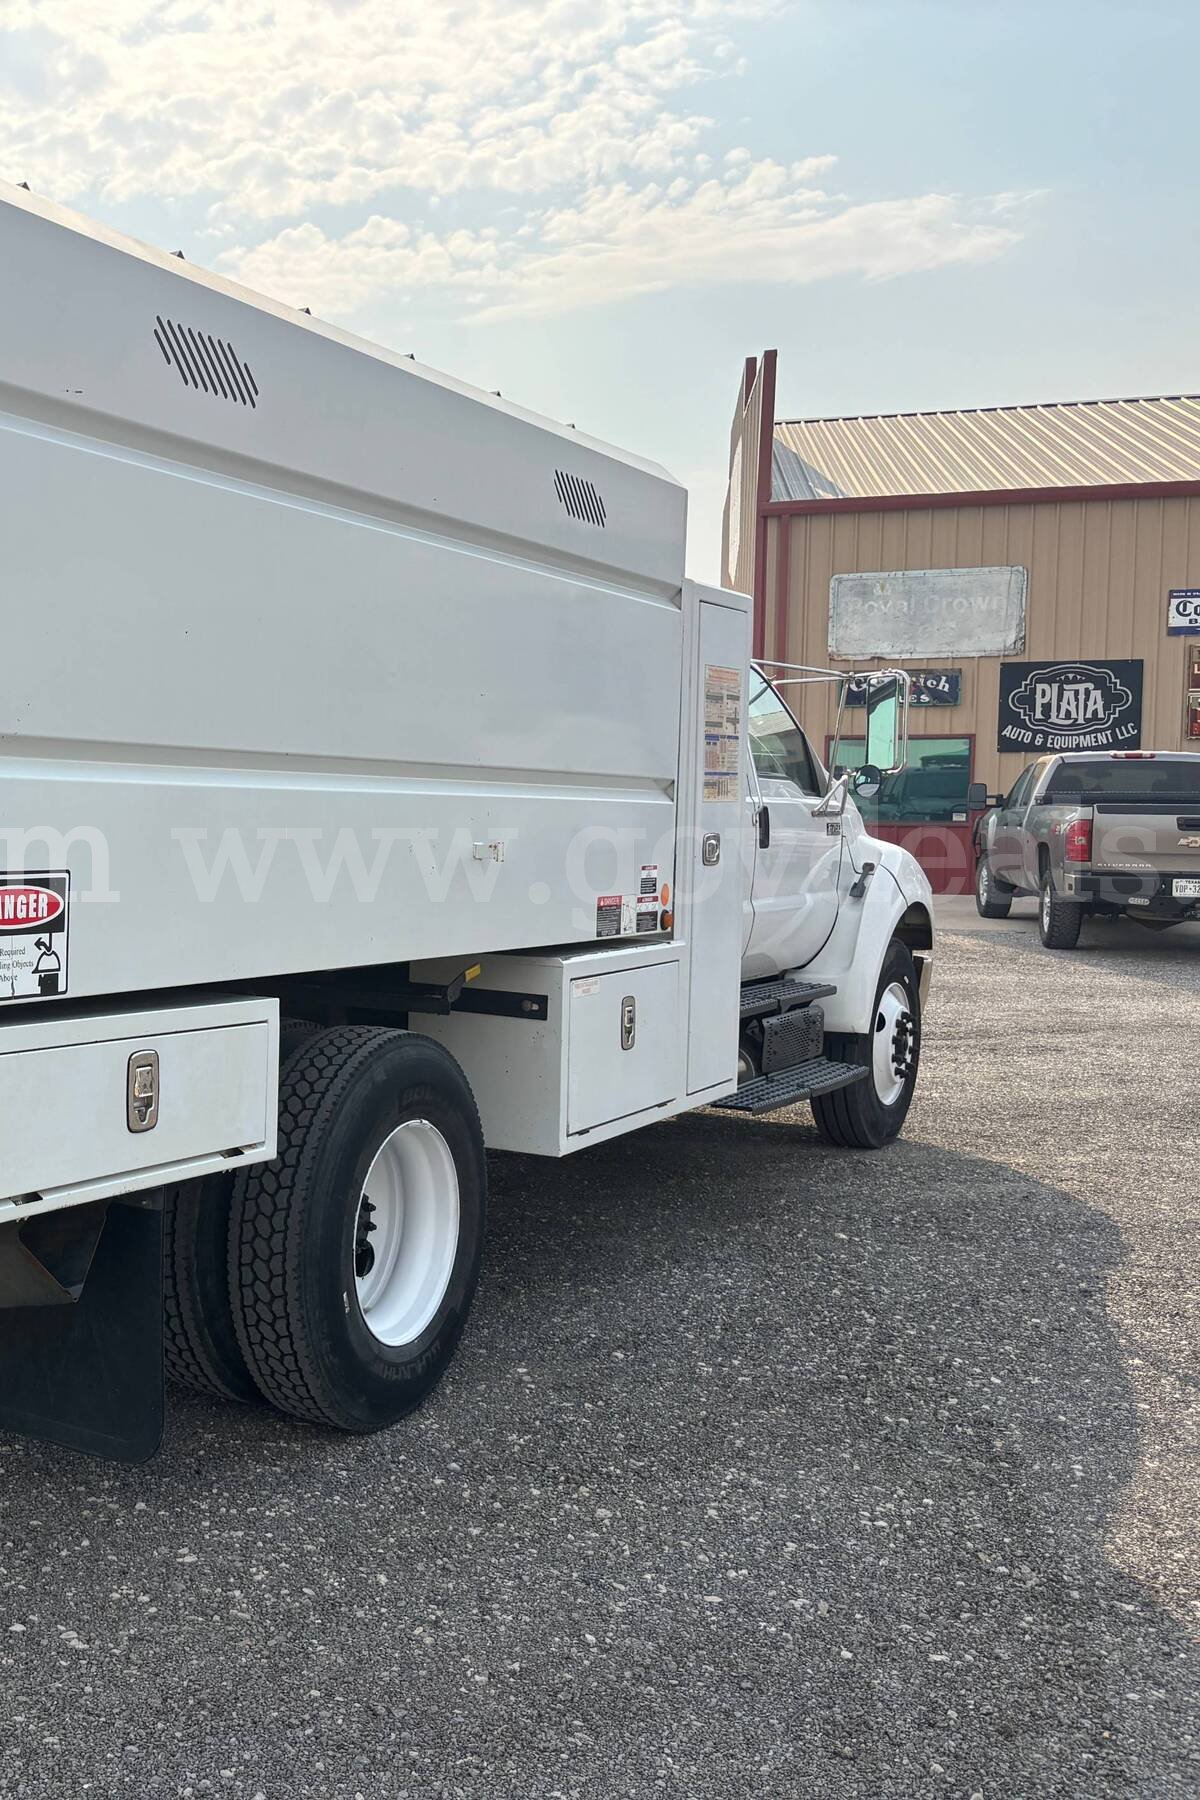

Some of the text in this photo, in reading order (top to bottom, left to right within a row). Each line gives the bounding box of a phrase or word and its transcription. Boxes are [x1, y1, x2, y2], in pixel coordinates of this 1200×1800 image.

[1034, 682, 1105, 725] PLATA
[1001, 722, 1138, 749] AUTO & EQUIPMENT LLC
[11, 959, 34, 970] Objects
